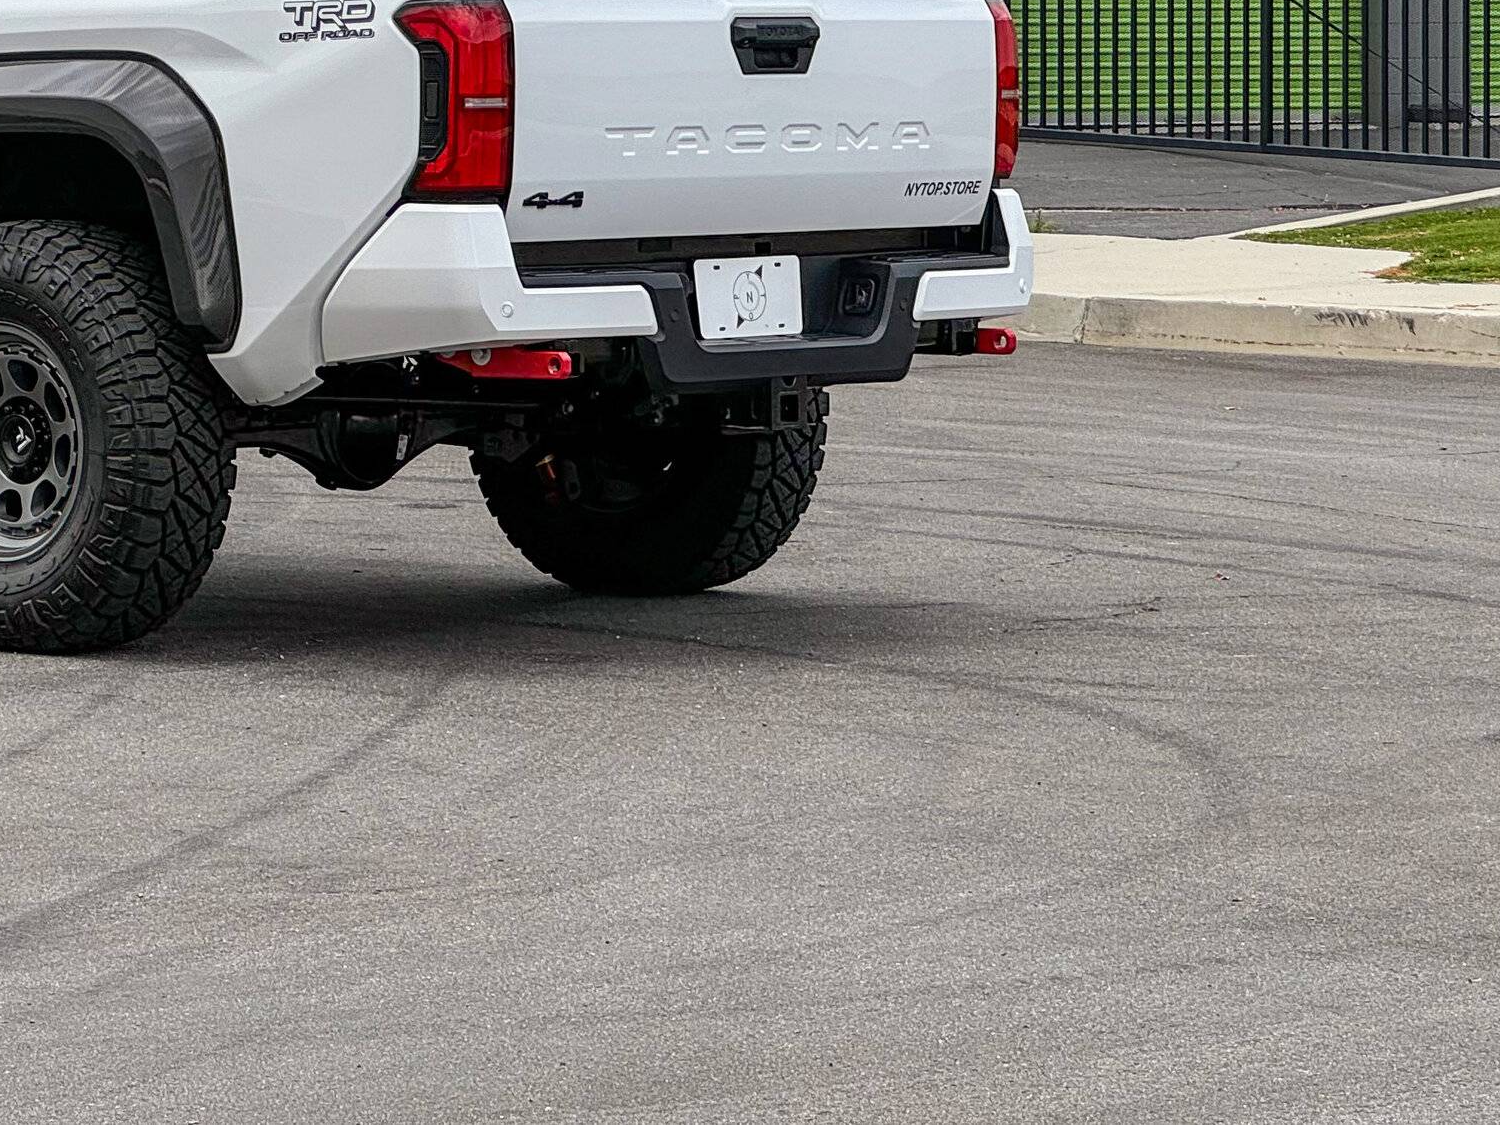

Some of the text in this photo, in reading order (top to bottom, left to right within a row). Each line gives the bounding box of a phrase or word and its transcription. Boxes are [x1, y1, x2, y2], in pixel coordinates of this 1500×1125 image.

[279, 28, 375, 43] OFF ROAD
[605, 121, 930, 158] TACOMA
[904, 180, 982, 196] NYTOP.STORE
